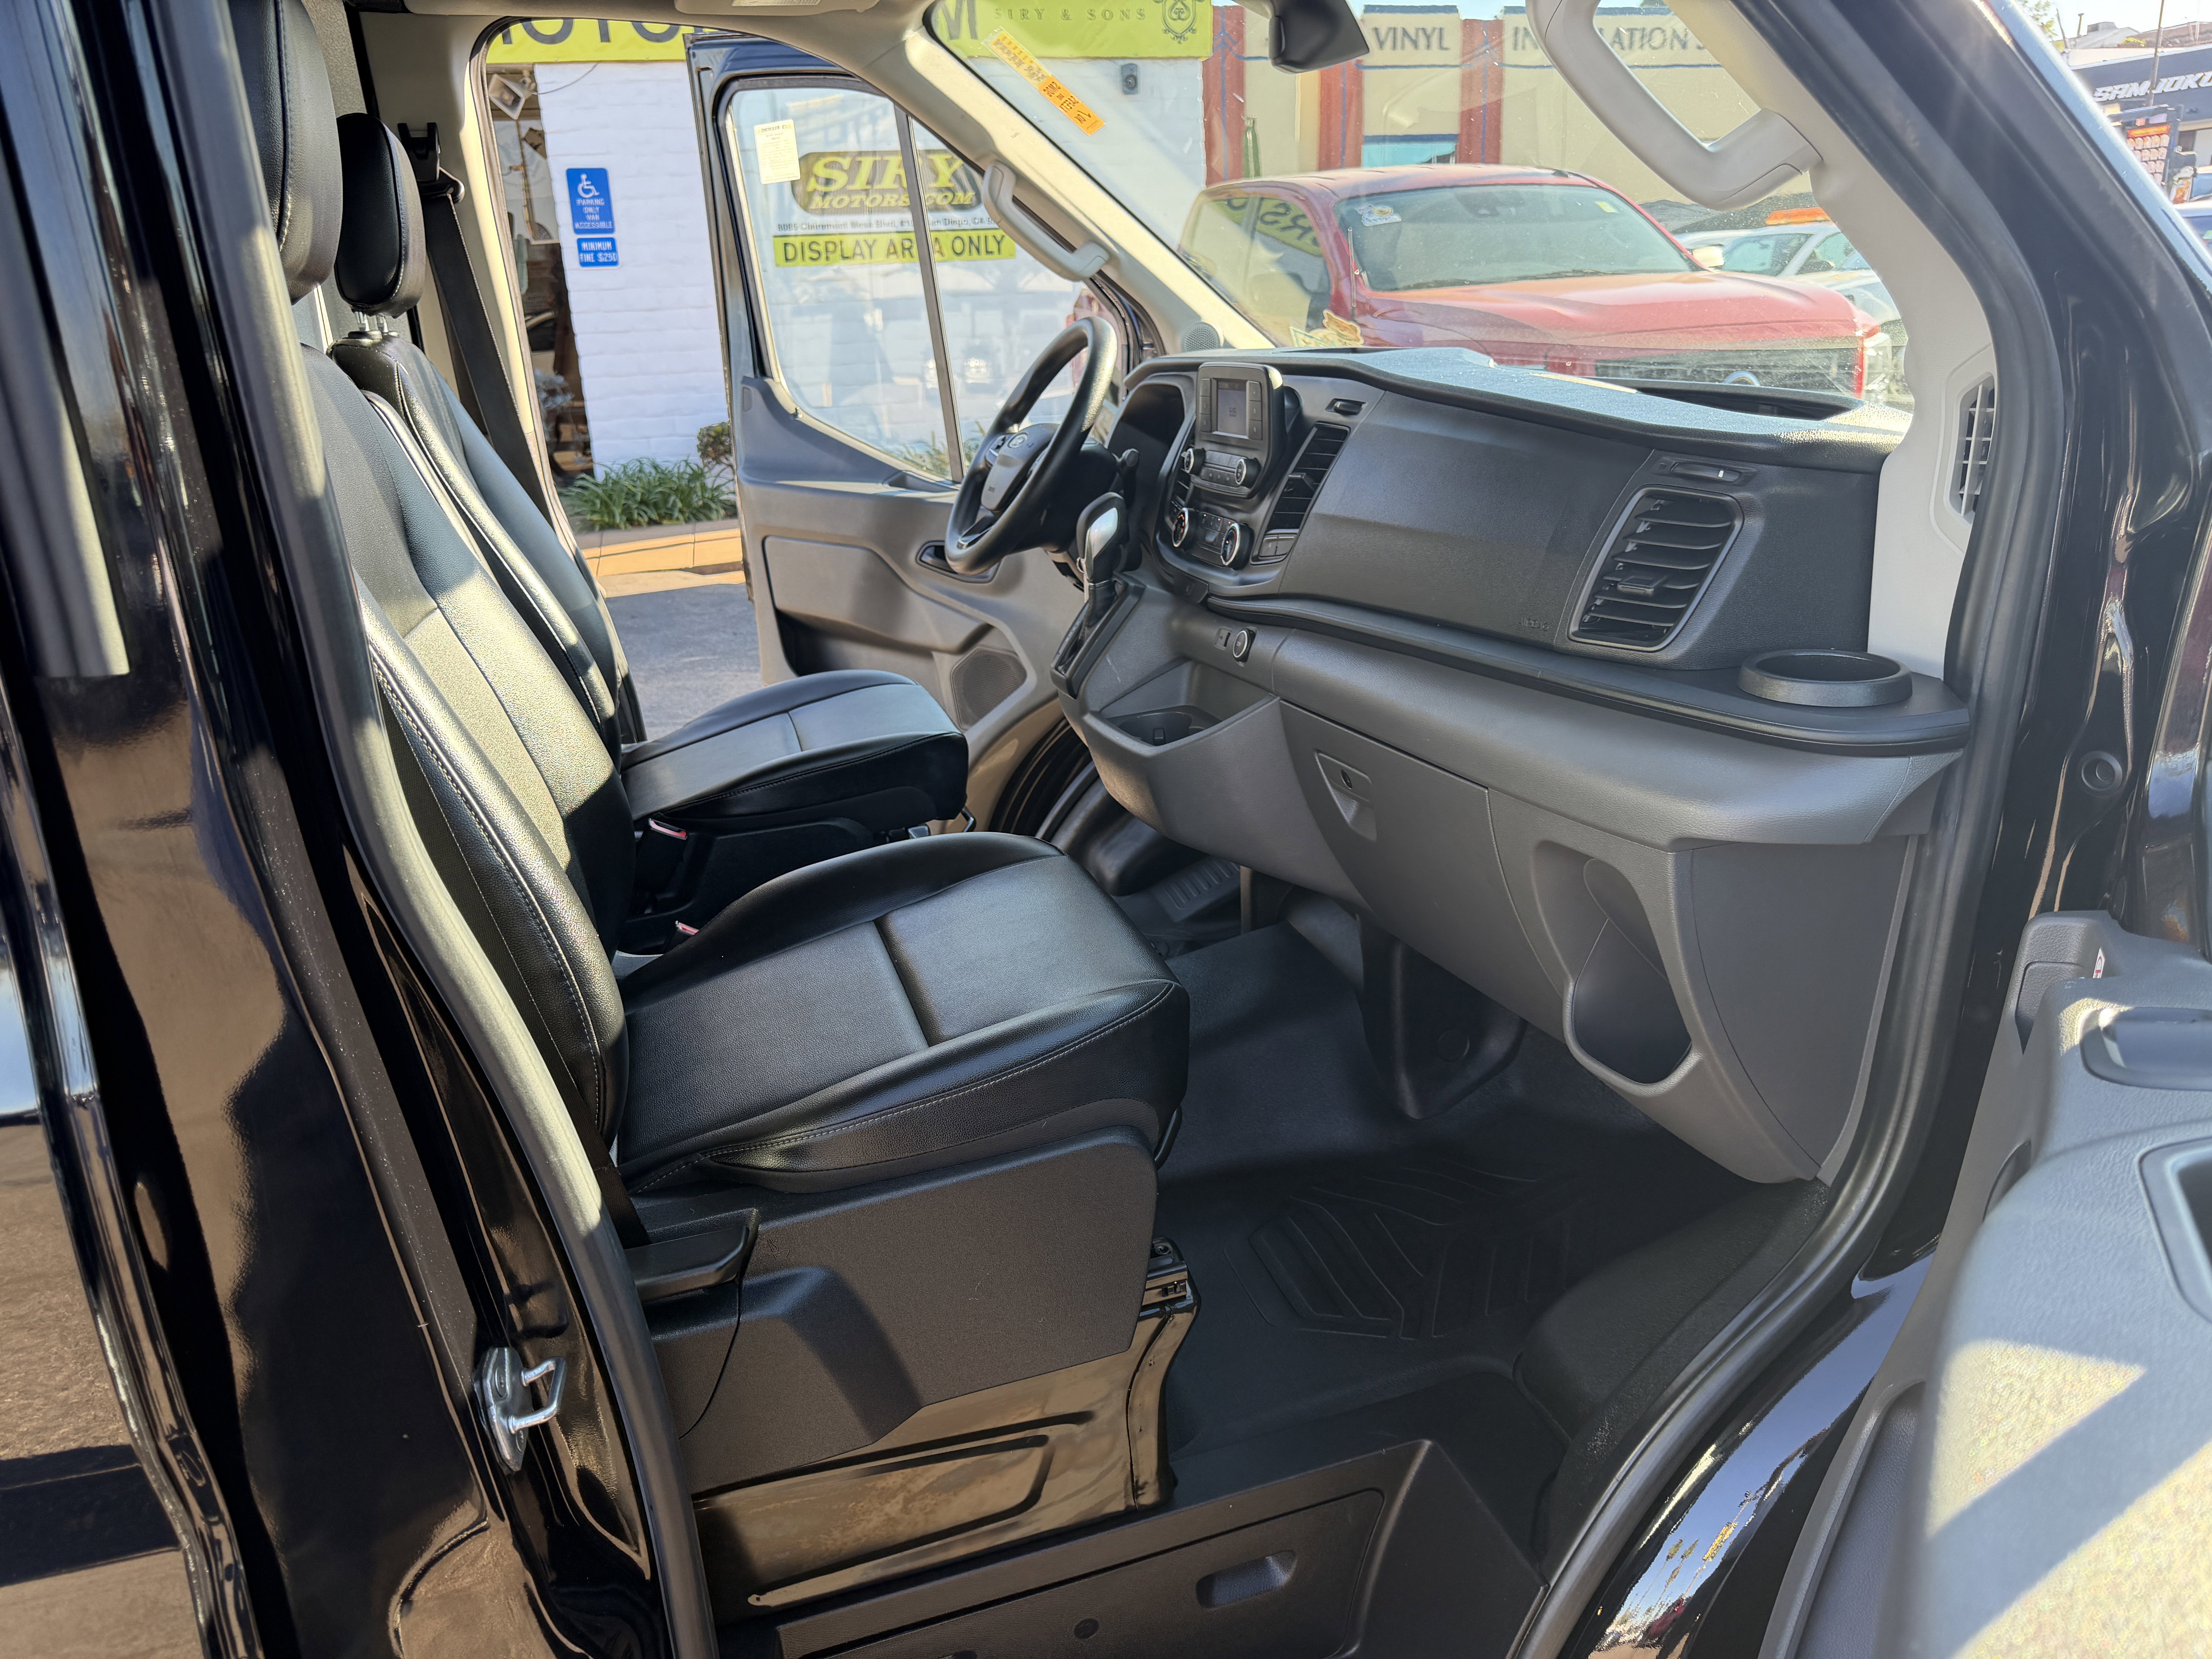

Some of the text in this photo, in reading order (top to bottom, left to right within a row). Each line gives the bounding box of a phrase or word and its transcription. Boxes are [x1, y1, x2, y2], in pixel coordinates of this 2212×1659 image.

[994, 8, 1146, 21] SIRY & SONS
[1373, 27, 1451, 51] VINYL
[582, 241, 612, 251] MINIMUM
[784, 235, 1006, 263] DISPLAY ARA ONLY
